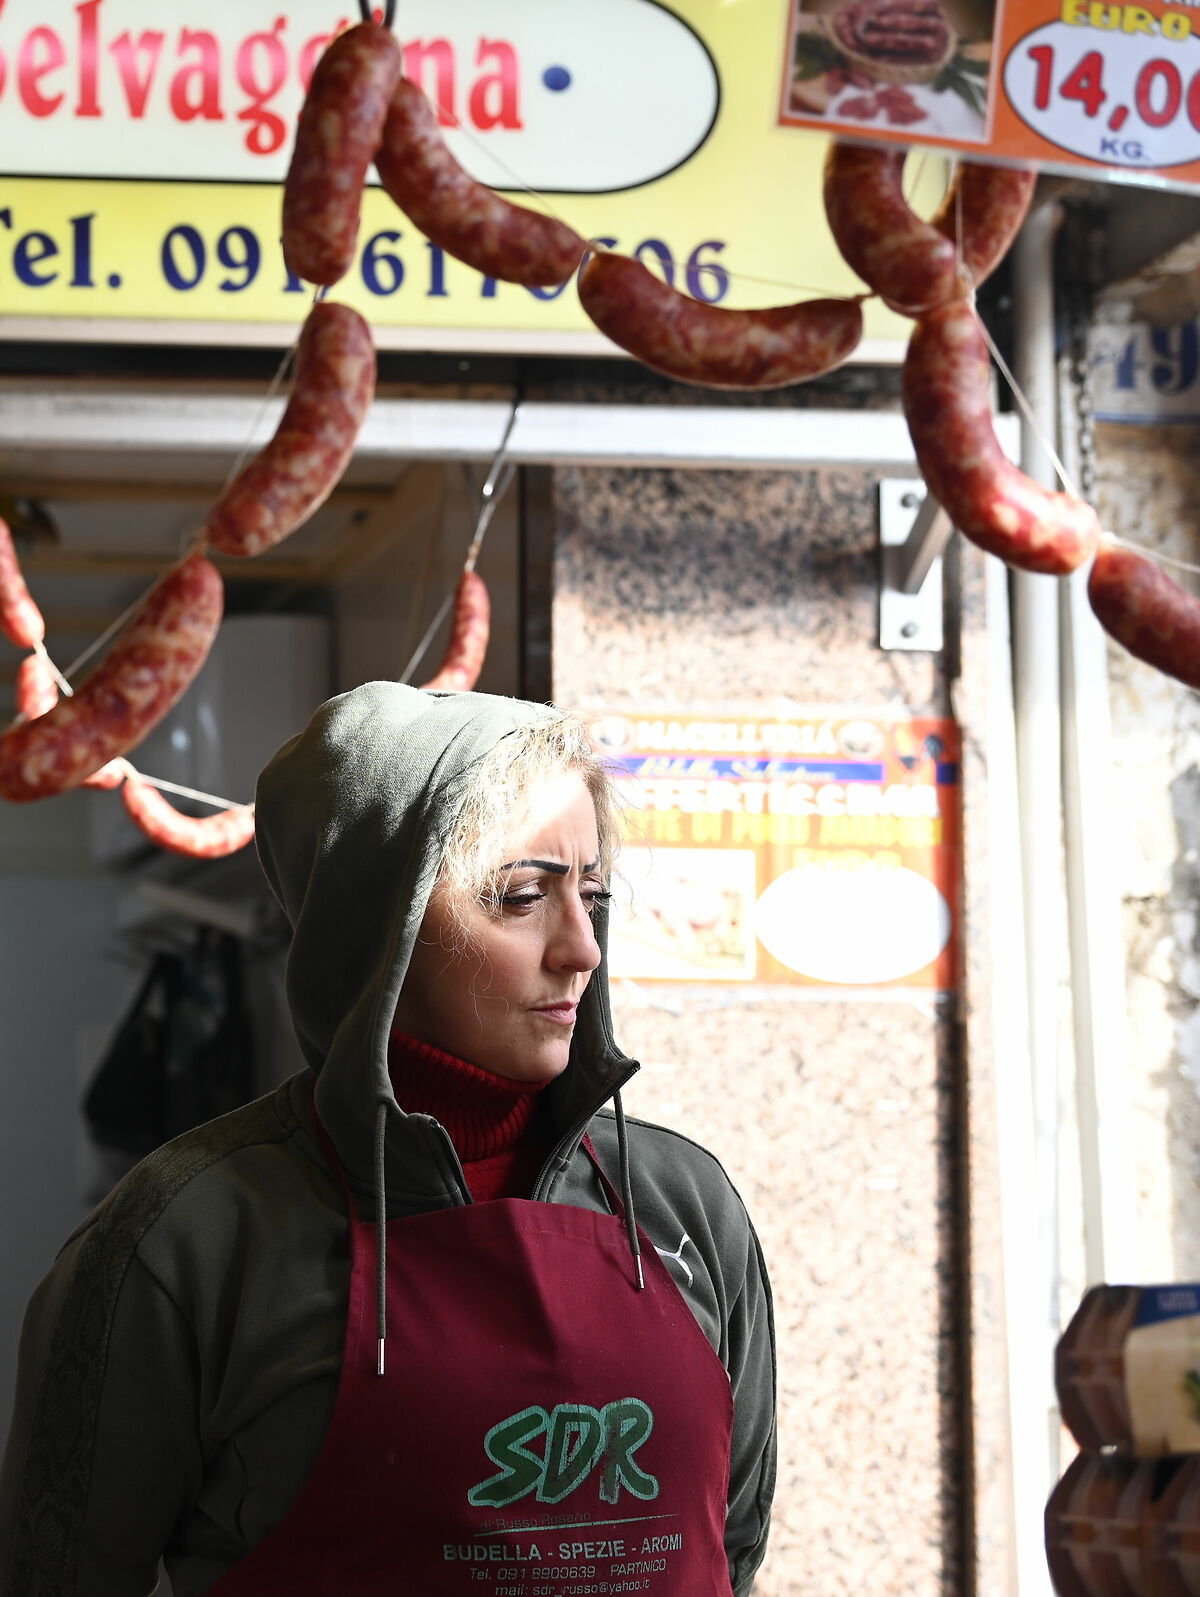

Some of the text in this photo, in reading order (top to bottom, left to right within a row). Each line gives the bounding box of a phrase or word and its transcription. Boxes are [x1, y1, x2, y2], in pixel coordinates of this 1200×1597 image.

[1062, 0, 1191, 40] EURO
[1028, 44, 1200, 132] 14,0
[467, 1397, 659, 1508] SDR
[443, 1544, 541, 1561] BUDELLA
[559, 1539, 626, 1560] SPEZIE
[640, 1533, 682, 1554] AROMI
[470, 1568, 492, 1580] Tel.
[497, 1567, 525, 1580] 091
[610, 1558, 667, 1577] PARTINICO
